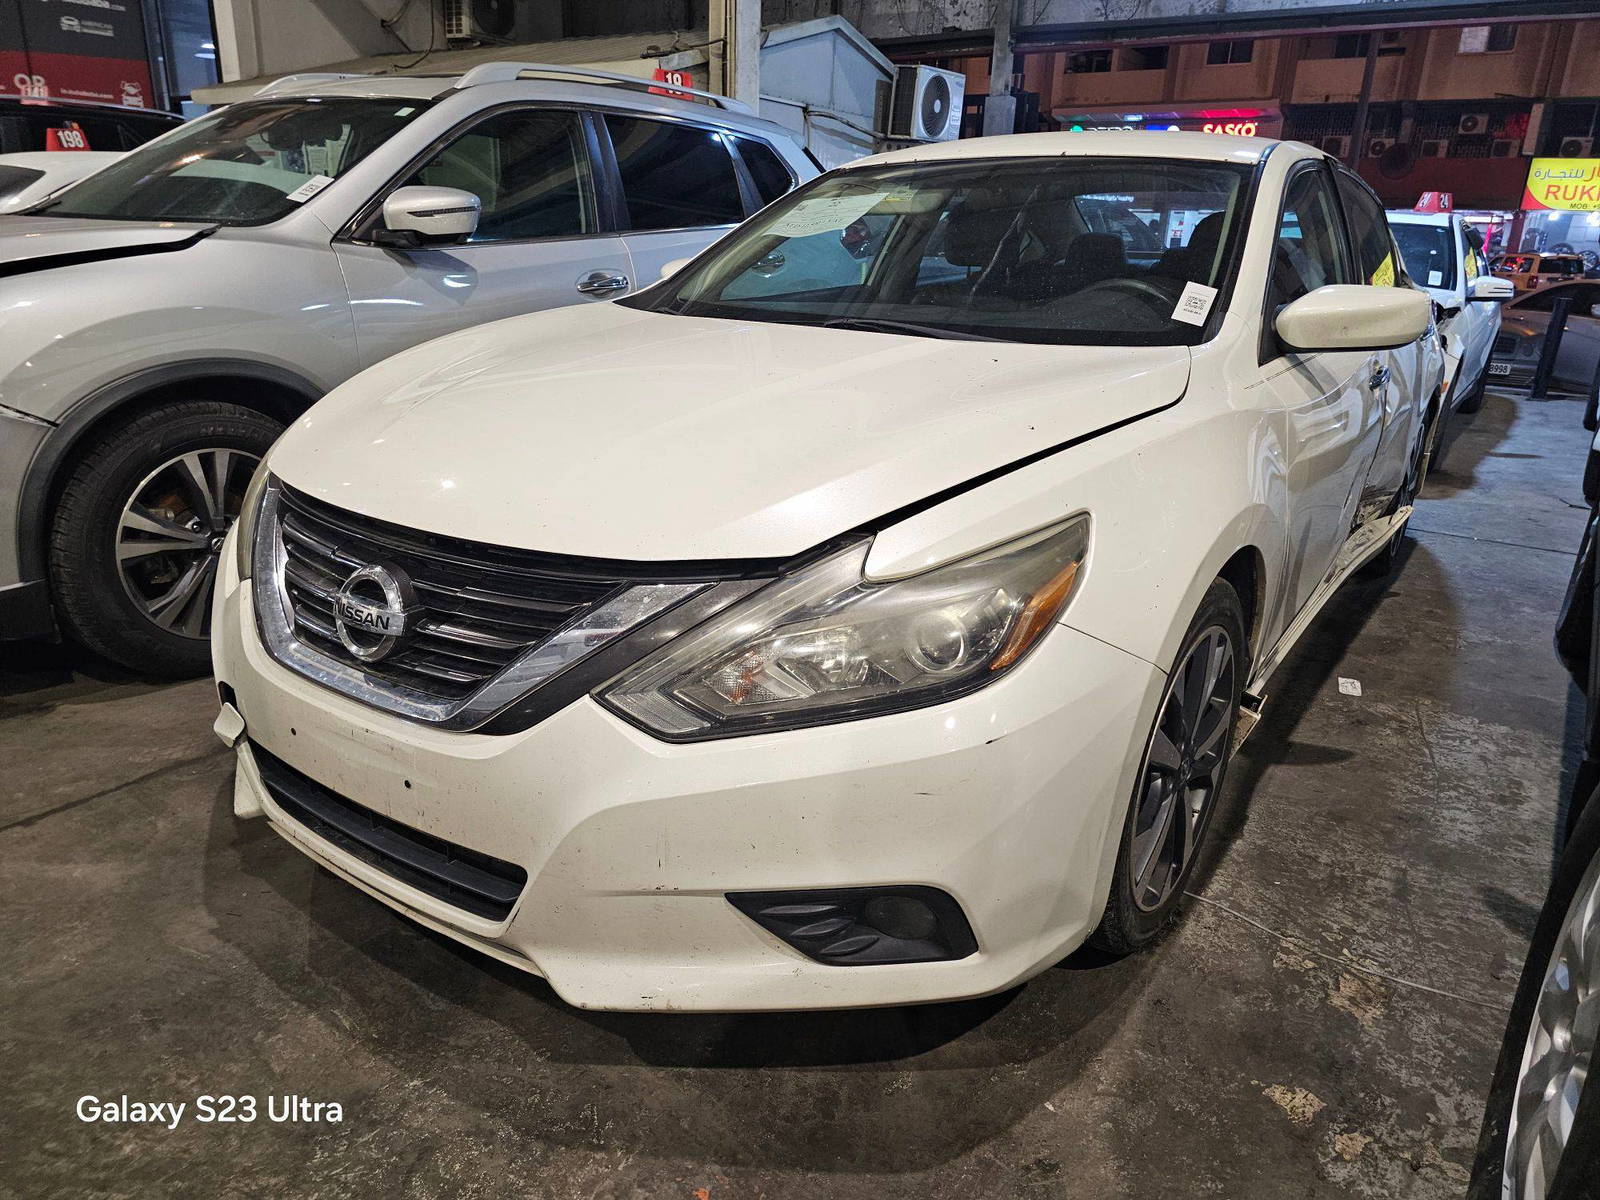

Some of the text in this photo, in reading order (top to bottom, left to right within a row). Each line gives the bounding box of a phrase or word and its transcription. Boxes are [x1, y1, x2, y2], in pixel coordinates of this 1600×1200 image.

[1203, 122, 1256, 137] SASCO
[57, 130, 84, 148] 198
[1534, 168, 1584, 181] للتجارة
[1544, 184, 1600, 201] RUK
[1440, 193, 1449, 209] 24
[335, 600, 390, 630] NISSAN
